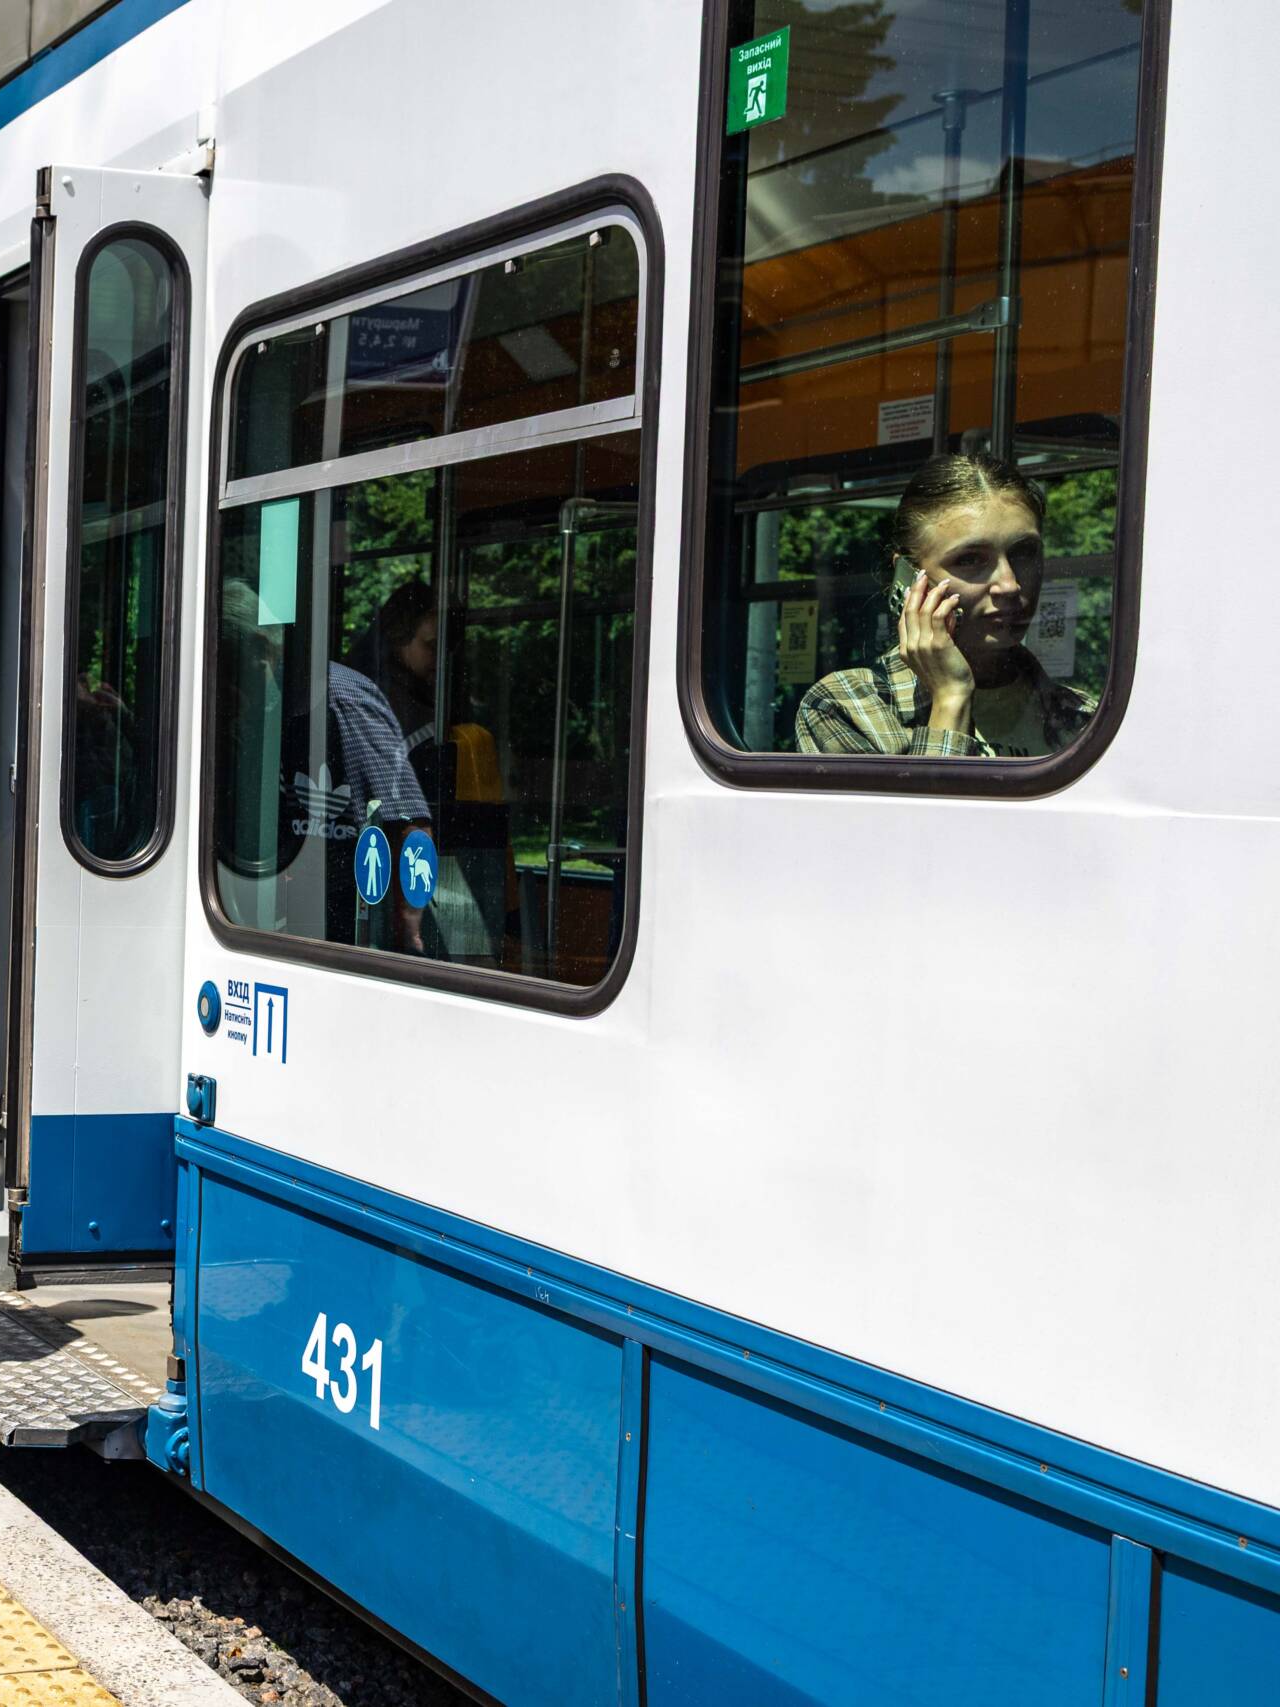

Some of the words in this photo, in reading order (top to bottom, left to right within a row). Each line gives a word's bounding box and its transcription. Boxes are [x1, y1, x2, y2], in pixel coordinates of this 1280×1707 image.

[738, 35, 782, 62] Запасний
[747, 57, 772, 75] вихід
[291, 818, 358, 841] adidas
[227, 979, 250, 1004] ВХІД
[224, 1009, 252, 1026] Натисніть
[227, 1030, 247, 1045] кнопку
[302, 1312, 382, 1431] 431
